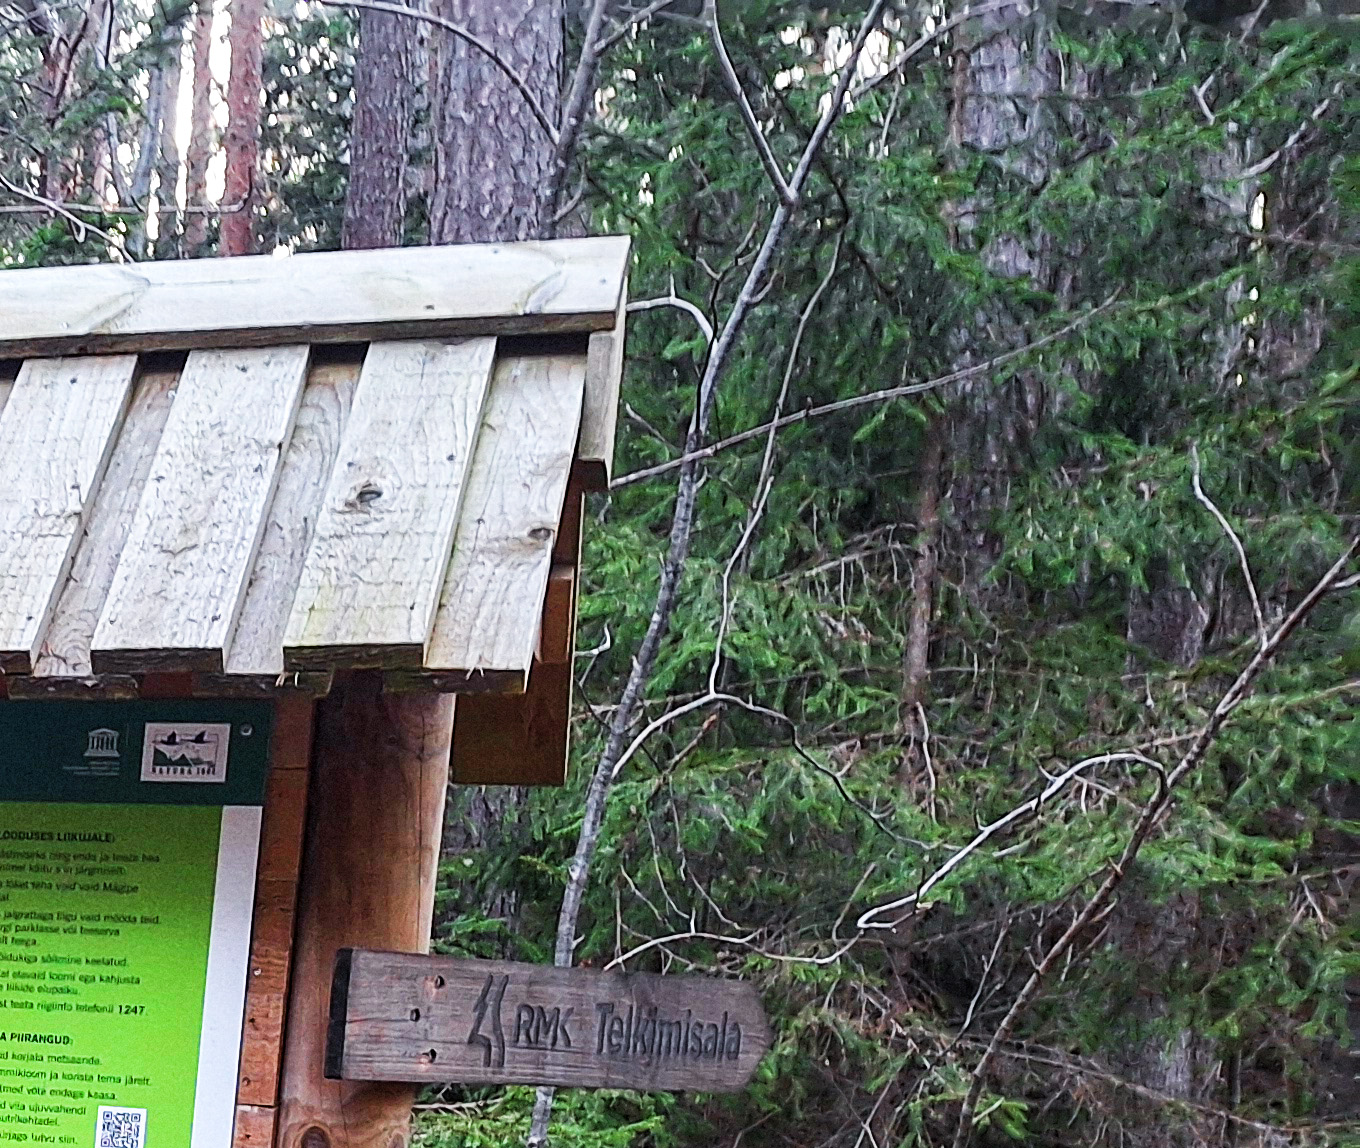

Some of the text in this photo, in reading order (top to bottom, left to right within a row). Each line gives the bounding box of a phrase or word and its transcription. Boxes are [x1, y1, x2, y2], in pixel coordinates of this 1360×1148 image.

[118, 1004, 147, 1015] 1247.
[513, 1002, 742, 1061] RMK Telkimisala
